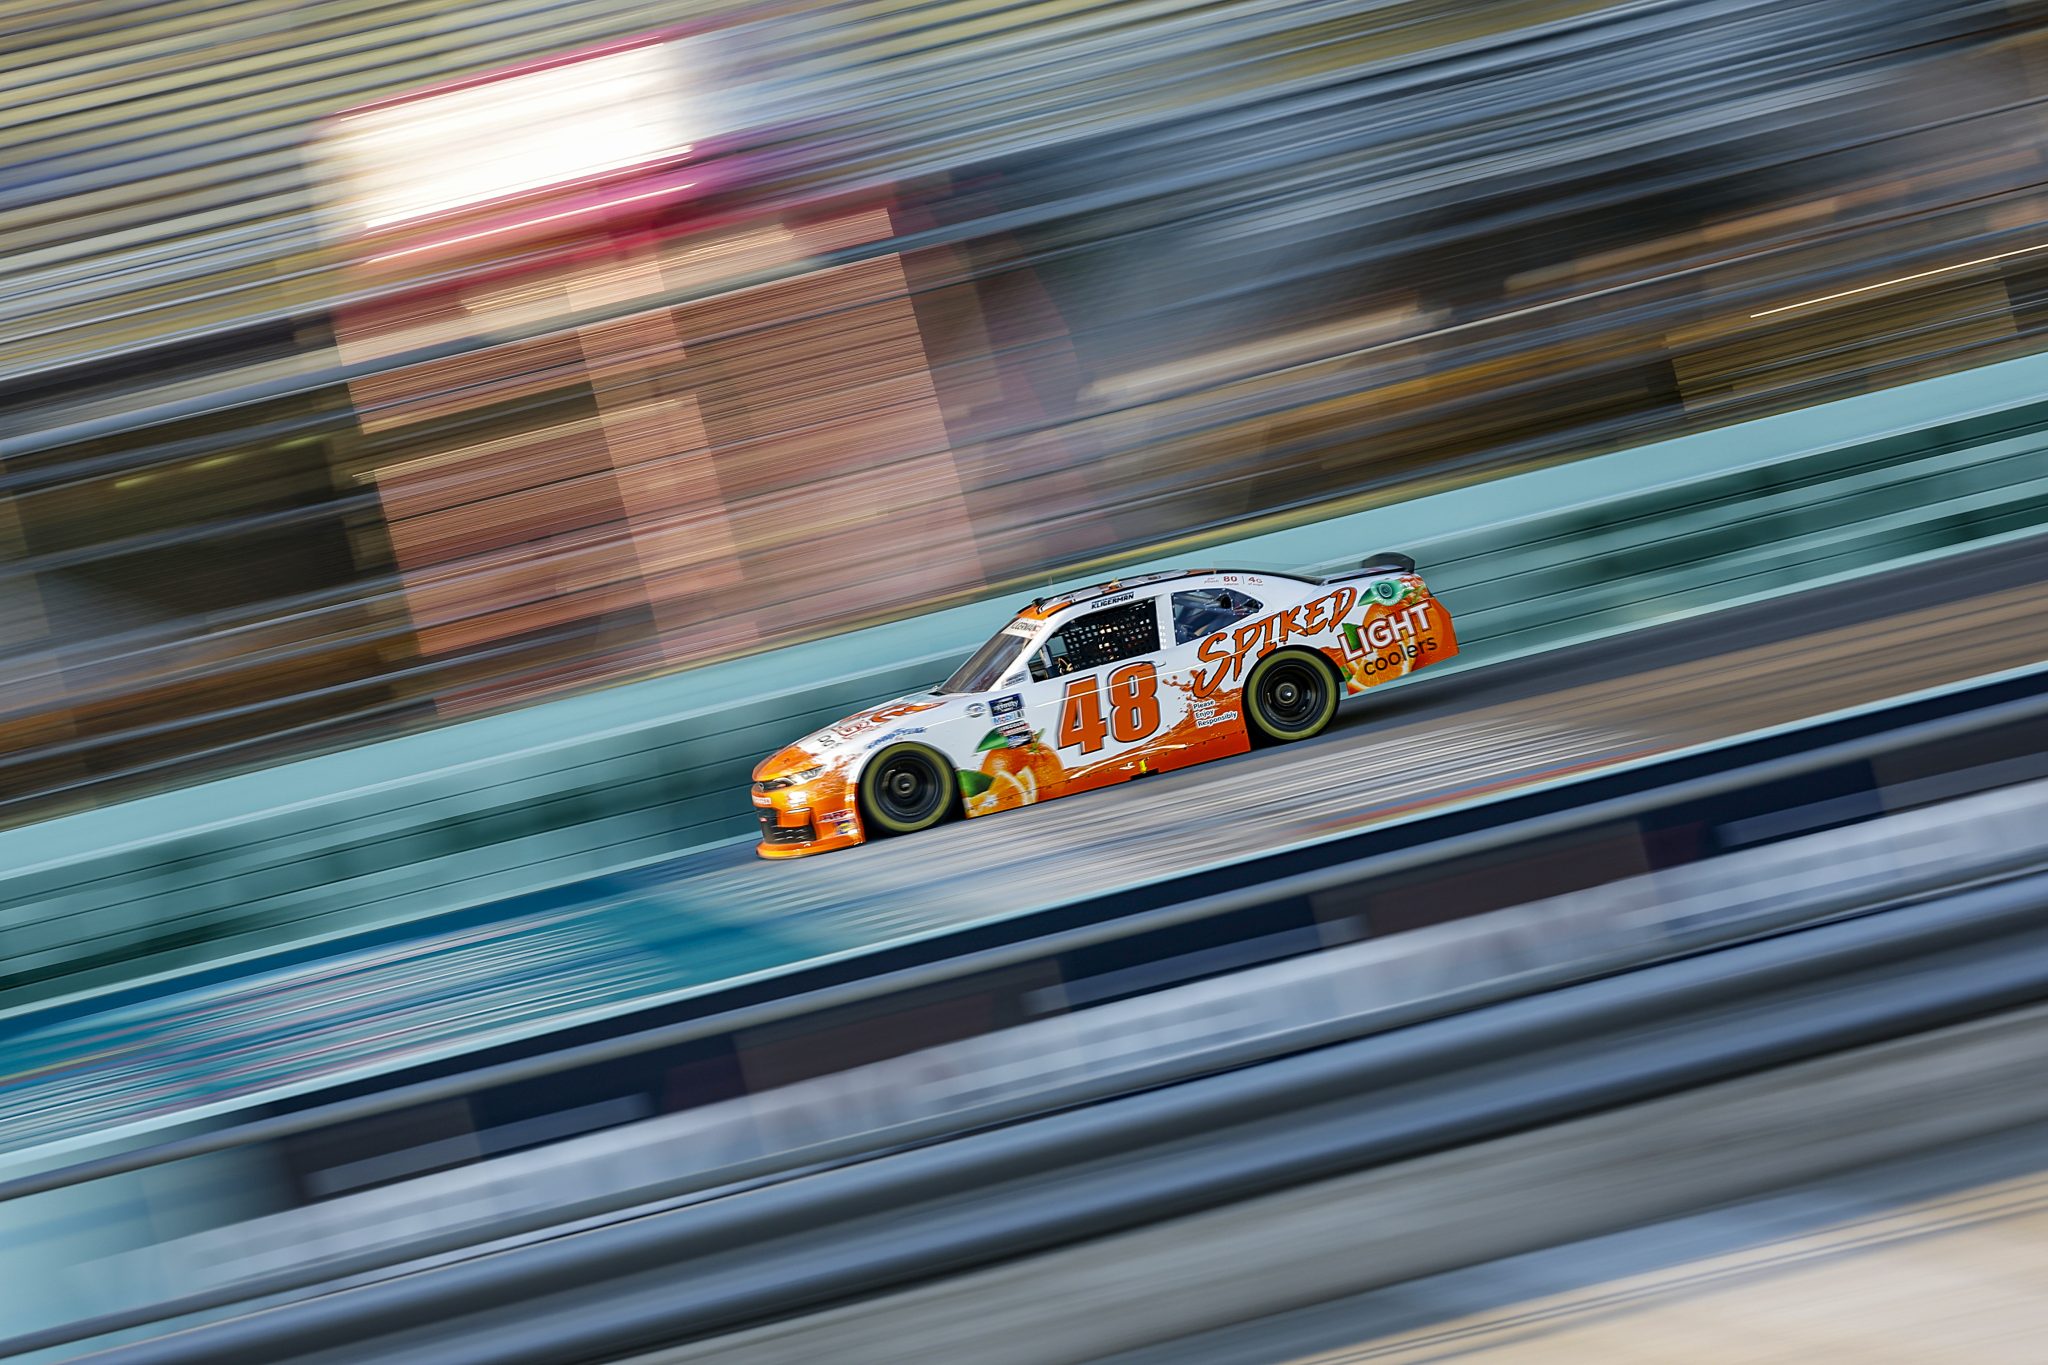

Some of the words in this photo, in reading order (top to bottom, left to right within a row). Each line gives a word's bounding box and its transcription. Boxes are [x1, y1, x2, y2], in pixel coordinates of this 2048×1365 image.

[1091, 592, 1135, 609] KLIGERMAN
[1192, 587, 1357, 698] SPIKED
[1338, 600, 1432, 661] LIGHT
[1364, 634, 1438, 676] coolers
[1057, 661, 1161, 755] 48
[1193, 699, 1215, 710] Please
[1195, 710, 1214, 719] Enjoy
[1197, 711, 1238, 727] Responsibly
